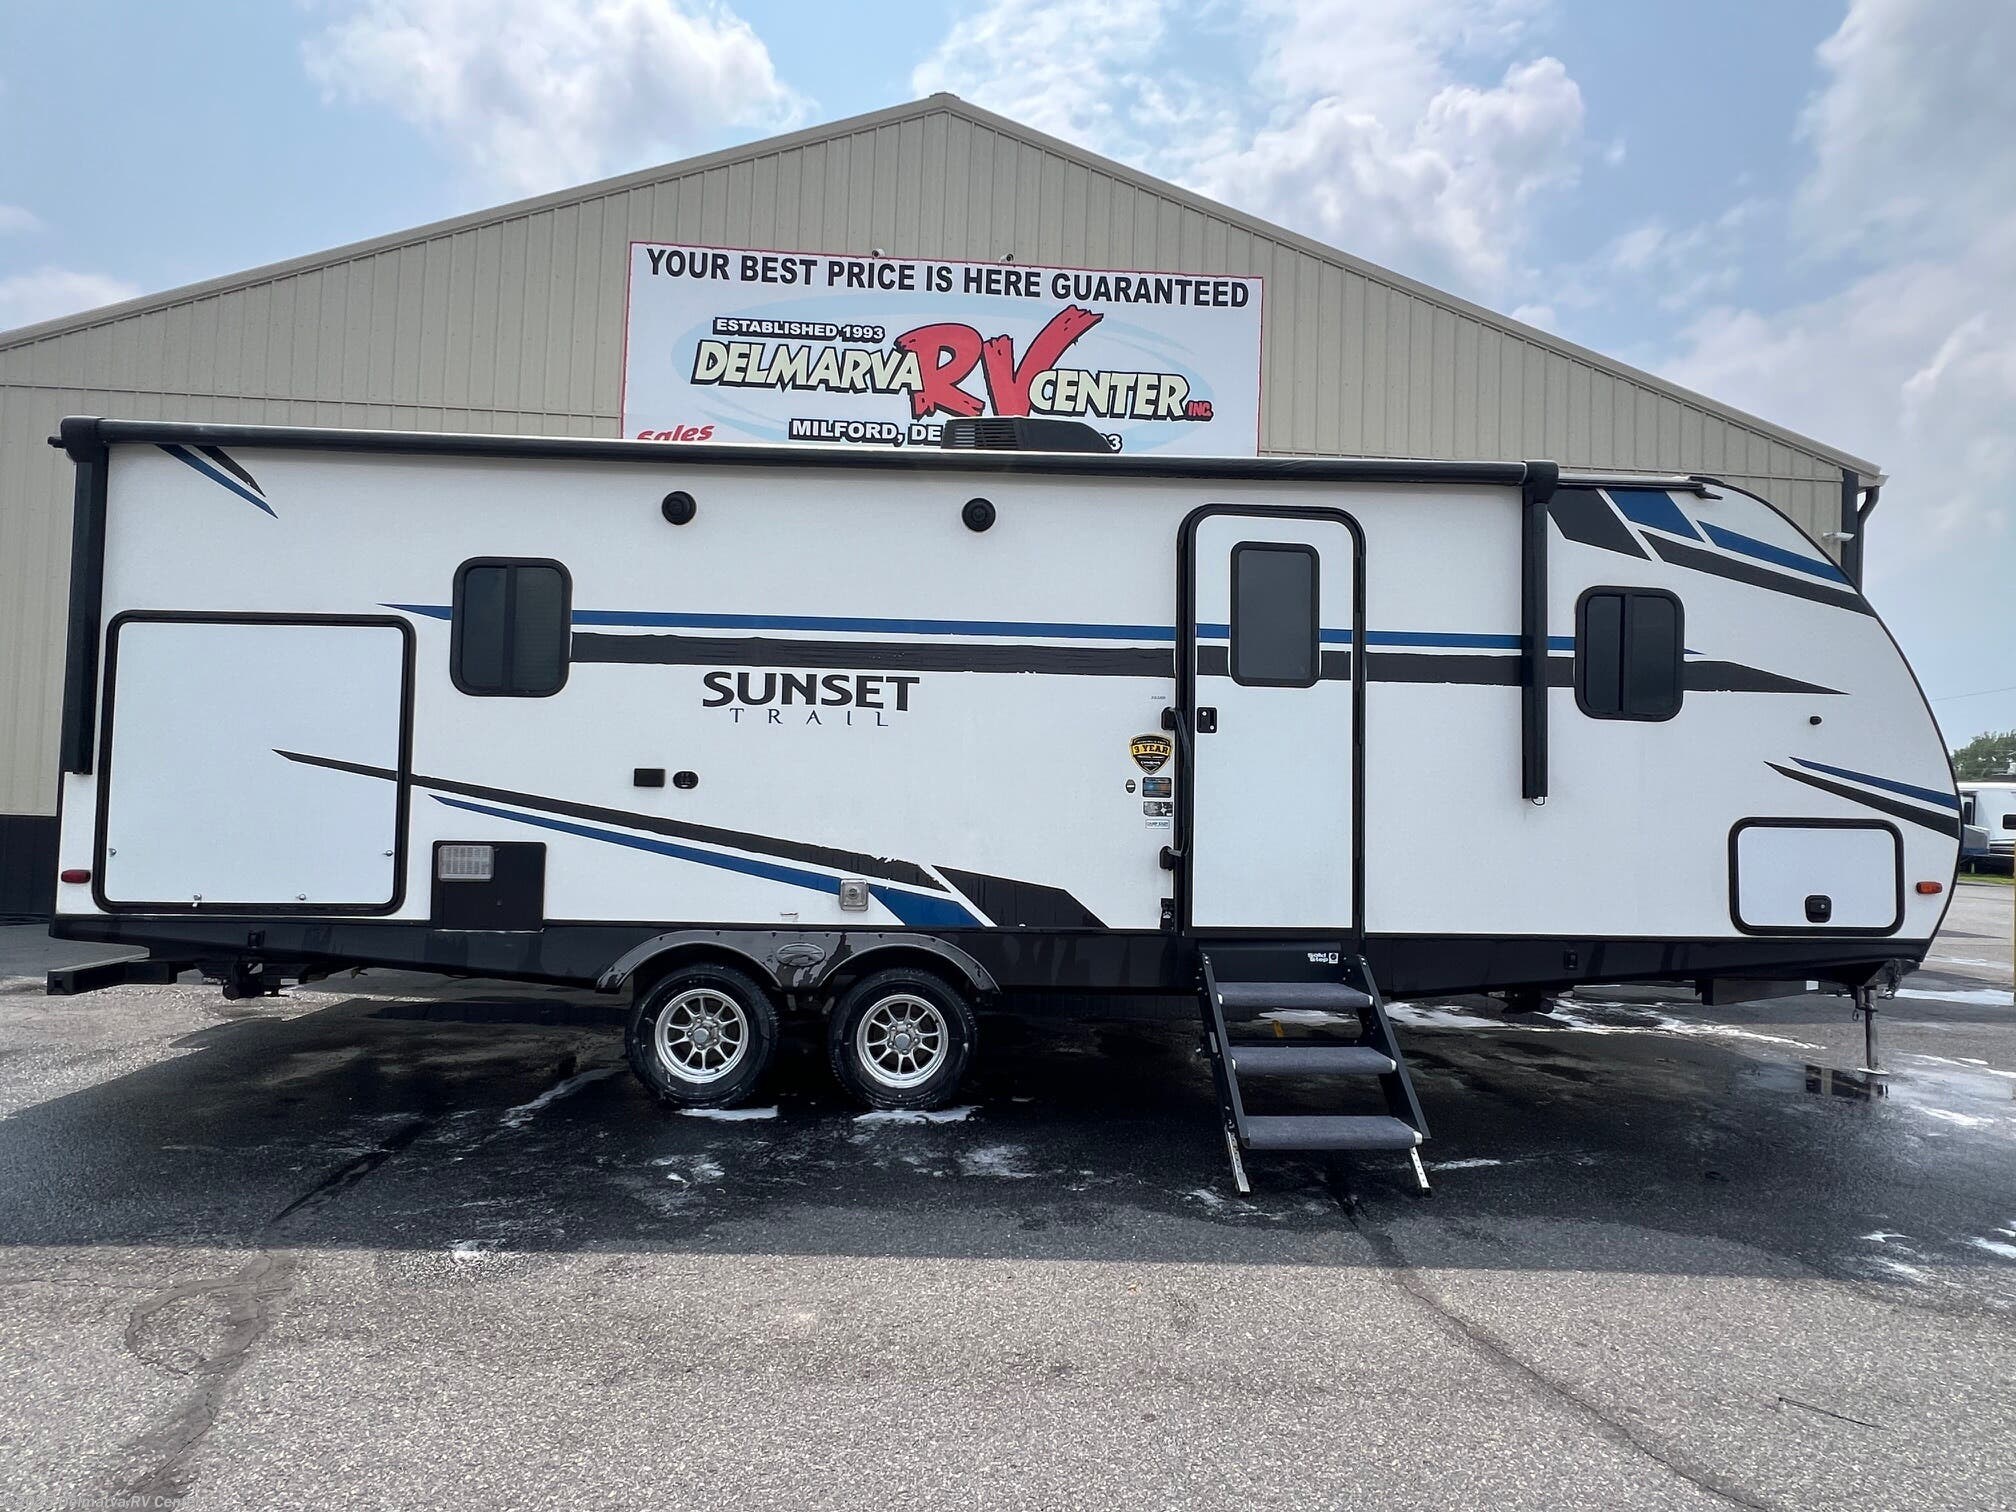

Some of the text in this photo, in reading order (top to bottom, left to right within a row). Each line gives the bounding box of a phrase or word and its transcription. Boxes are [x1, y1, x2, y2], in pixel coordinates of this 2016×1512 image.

[646, 248, 1249, 308] YOUR BEST PRICE IS HERE GUARANTEED
[715, 318, 885, 340] ESTABLISHED 1993
[693, 339, 924, 393] DELMARVA
[895, 304, 1104, 419] RV
[1028, 368, 1190, 418] CENTER
[791, 419, 942, 445] MILFORD, DE
[702, 671, 921, 712] SUNSET
[729, 707, 889, 727] TRAIL
[1142, 744, 1169, 755] YEAR
